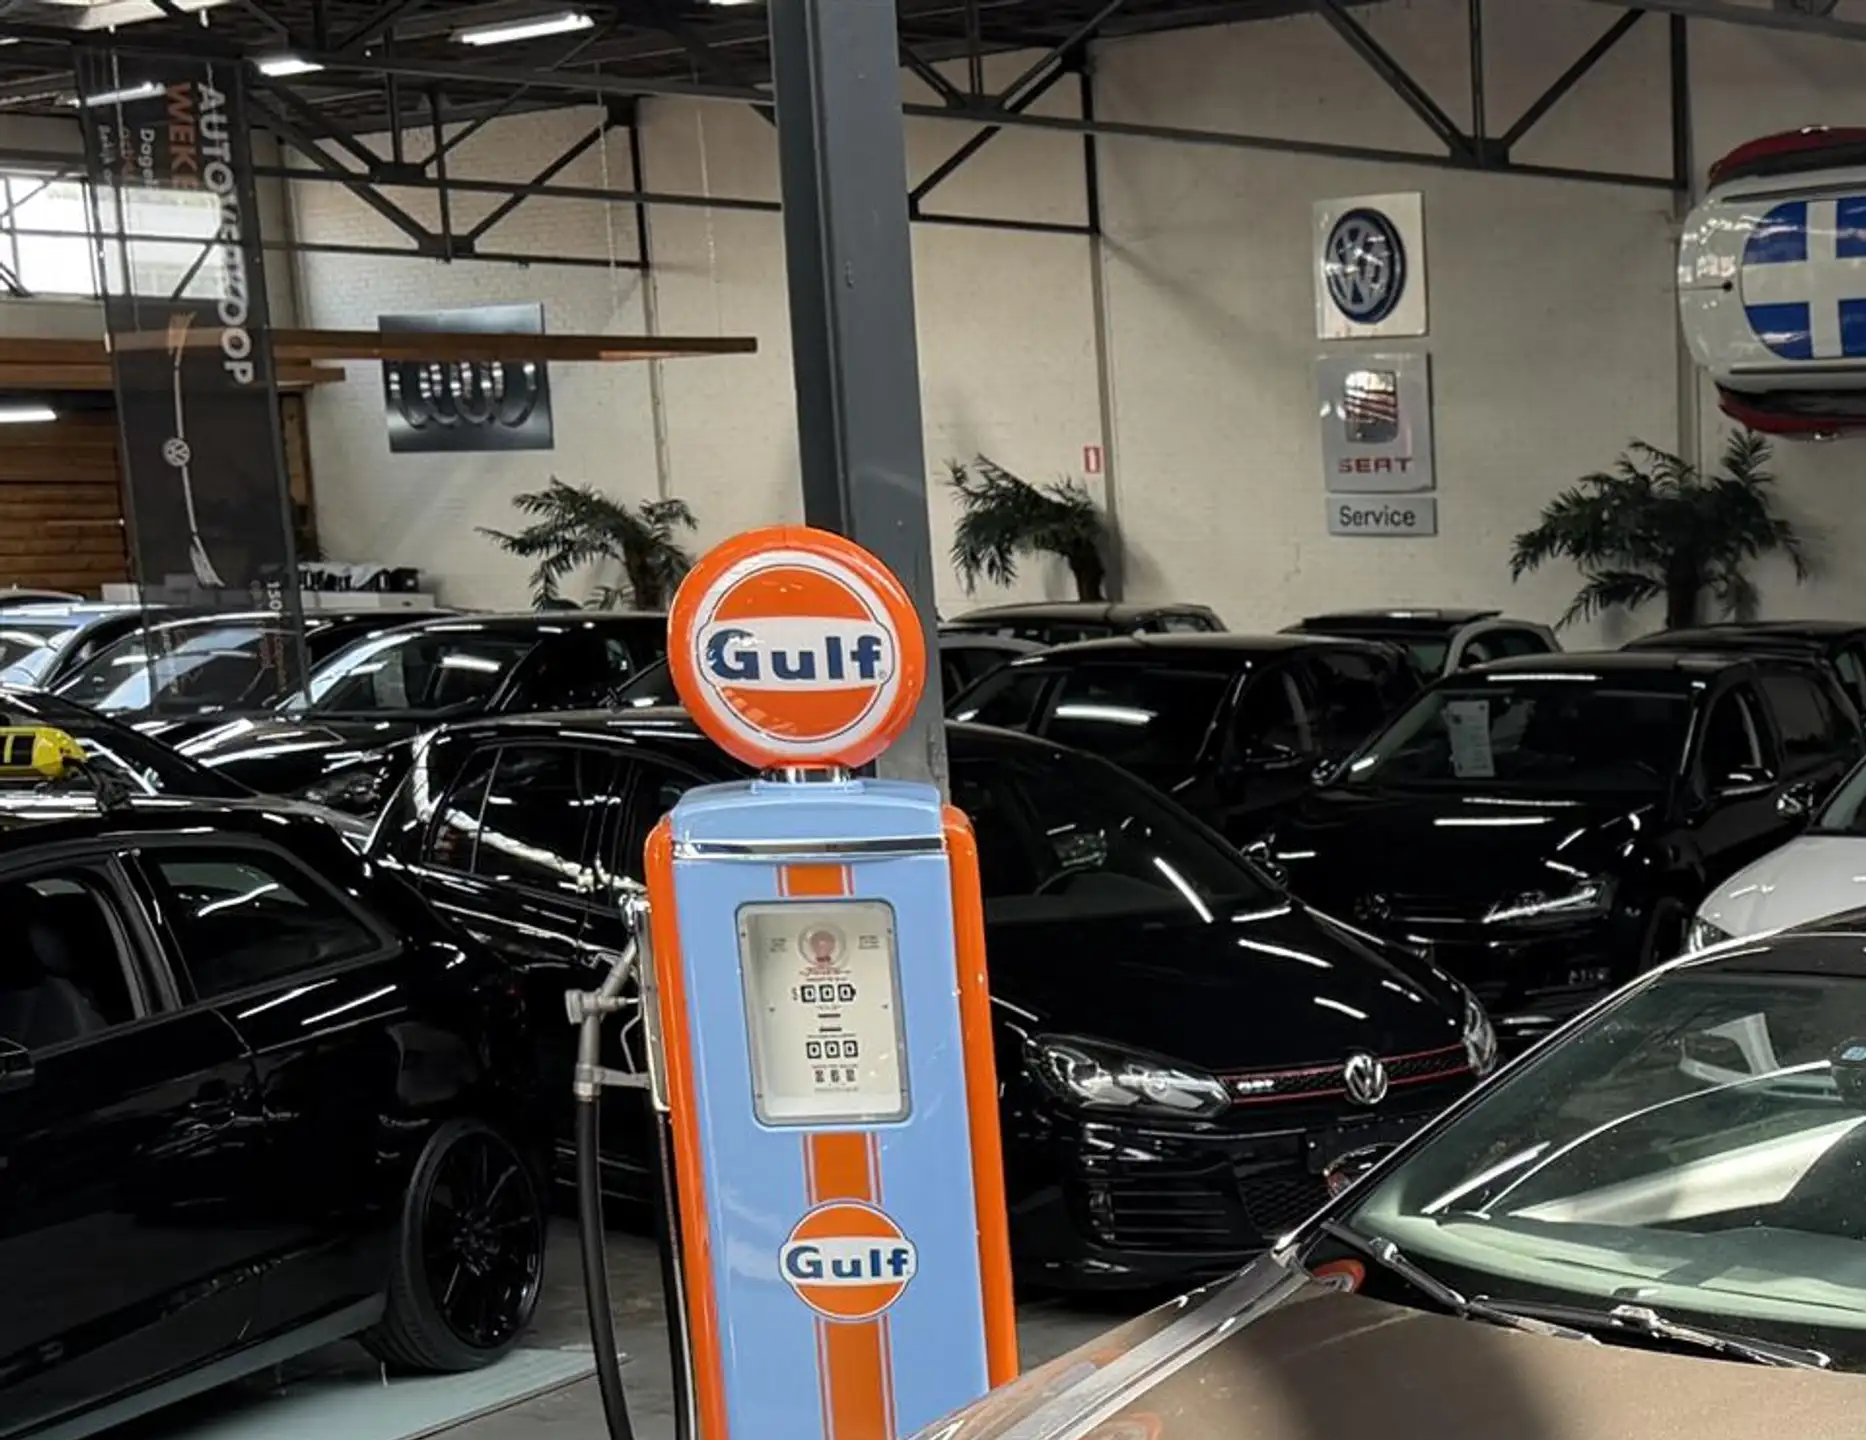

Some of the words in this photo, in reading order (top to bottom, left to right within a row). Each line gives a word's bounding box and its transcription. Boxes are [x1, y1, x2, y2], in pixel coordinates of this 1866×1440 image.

[1338, 457, 1413, 474] SEAT
[1339, 505, 1416, 528] Service
[705, 628, 882, 680] Gulf
[785, 1245, 909, 1279] Gulf
